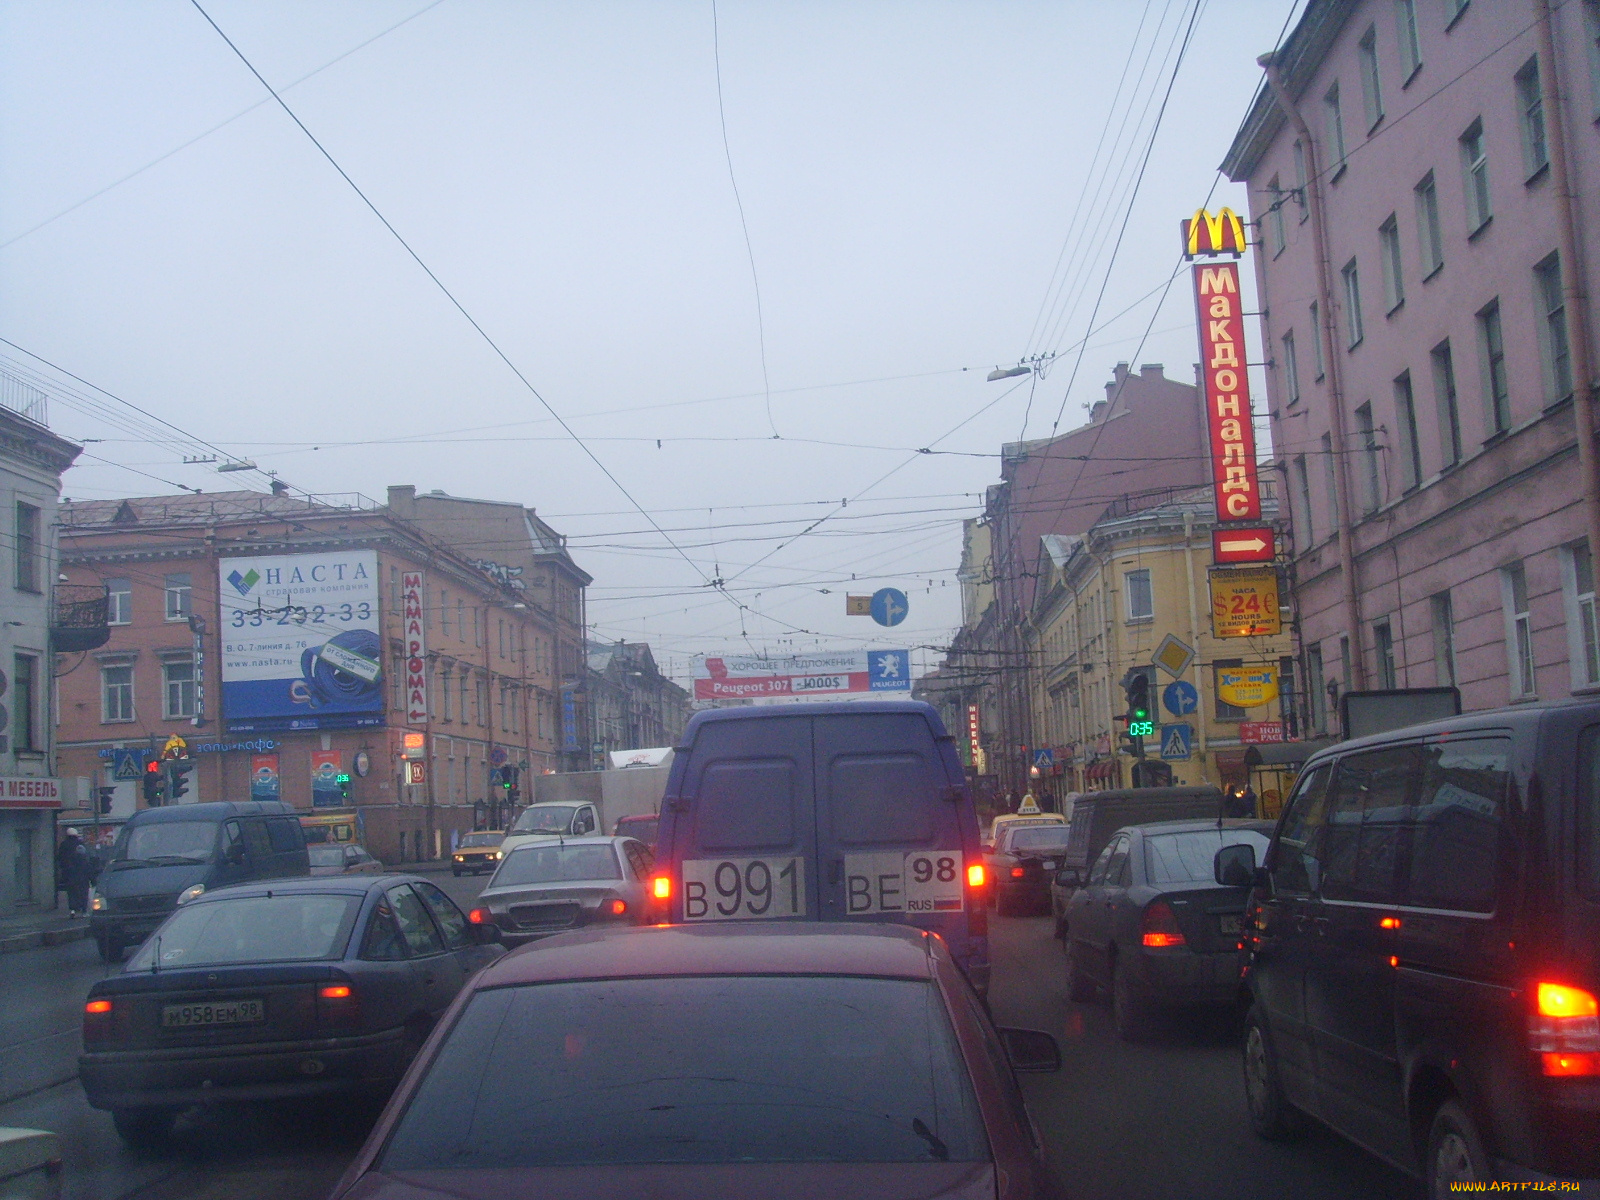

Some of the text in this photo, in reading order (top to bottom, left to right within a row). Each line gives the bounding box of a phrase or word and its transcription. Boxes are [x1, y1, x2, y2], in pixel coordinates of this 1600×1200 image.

[1200, 267, 1250, 517] Макдоналдс
[265, 562, 369, 585] НАСТА
[265, 582, 369, 596] страховая компания
[1230, 594, 1260, 614] 24
[1227, 620, 1250, 628] ВИДОВ
[1231, 613, 1262, 621] HOURS
[296, 640, 307, 650] 76
[404, 574, 425, 705] МАМА РОМА
[227, 657, 293, 668] www.nasta.ru
[730, 660, 779, 672] ХОРОШЕЕ
[783, 657, 856, 670] ПРЕДЛОЖЕНИЕ
[713, 681, 764, 695] Peugeot
[767, 680, 789, 691] 307
[872, 680, 907, 688] PEUGEOT
[968, 705, 978, 754] МЕБЕЛЬ
[9, 781, 58, 797] МЕБЕЛЬ
[912, 857, 957, 883] 98
[907, 900, 932, 911] RUS
[169, 1002, 258, 1025] М958ЕМ 98
